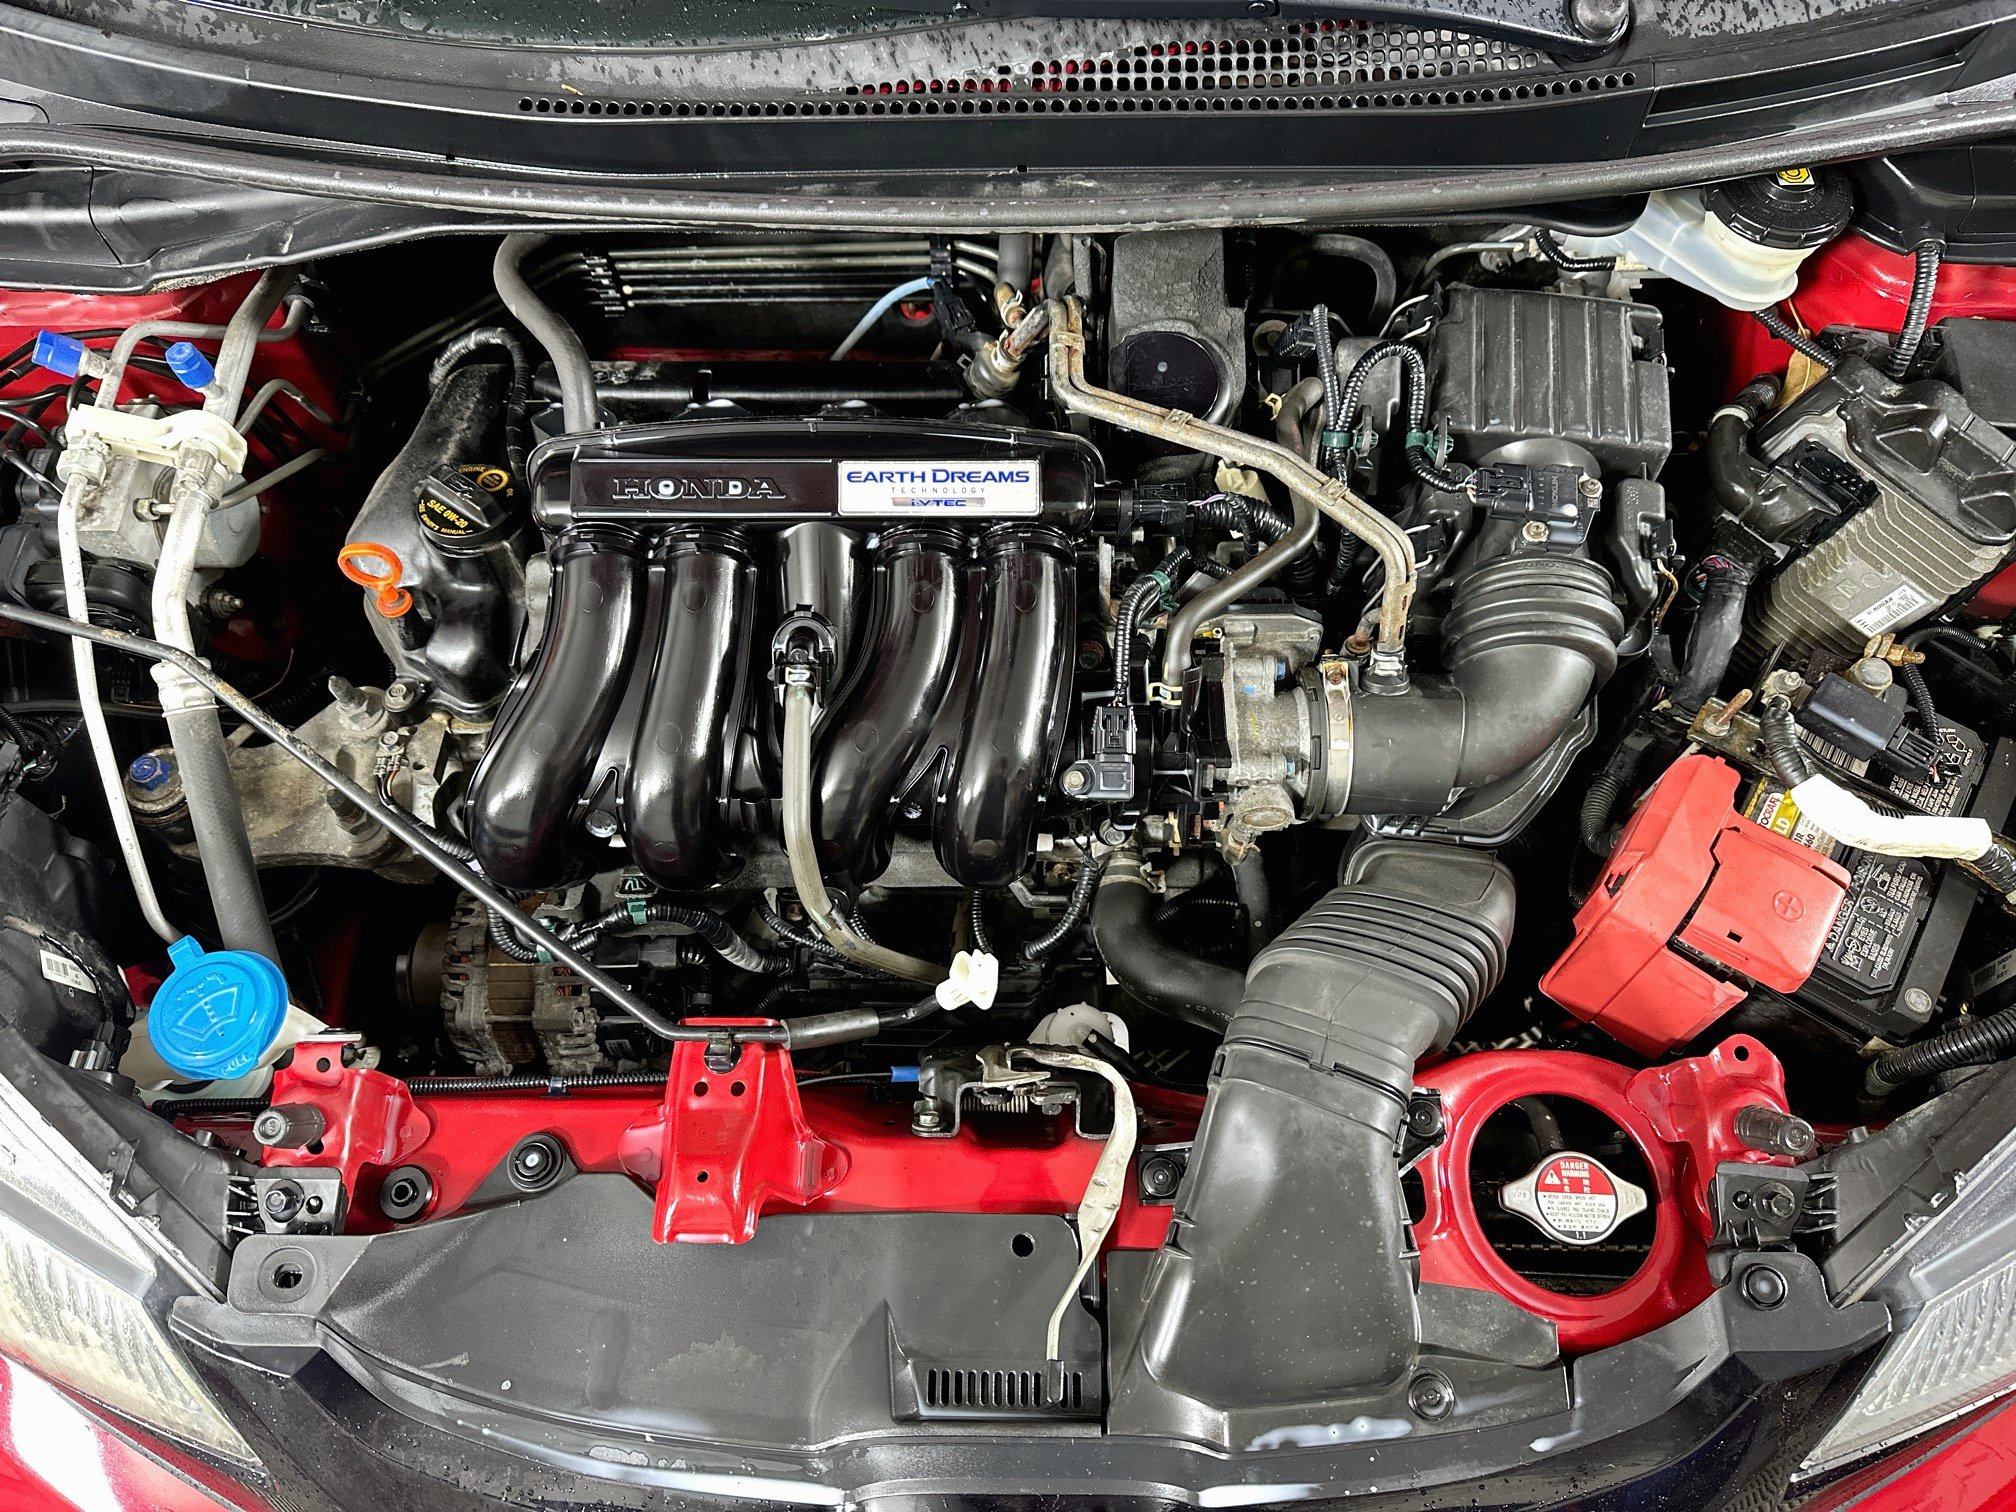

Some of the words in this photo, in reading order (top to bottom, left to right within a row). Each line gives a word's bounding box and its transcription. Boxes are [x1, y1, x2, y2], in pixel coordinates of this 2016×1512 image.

[846, 470, 926, 483] EARTH
[931, 468, 1030, 483] DREAMS
[611, 476, 787, 500] HONDA
[426, 499, 447, 514] SAE
[442, 510, 469, 529] 0W-20
[440, 527, 467, 535] MANUAL
[1760, 796, 1780, 826] OCRAFT
[1830, 898, 1854, 939] DANGER
[1858, 926, 1870, 941] EYES
[221, 1052, 254, 1076] PULL
[1560, 1161, 1589, 1170] DANGER
[1561, 1169, 1590, 1178] WARNING
[1575, 1231, 1586, 1240] 1.1
